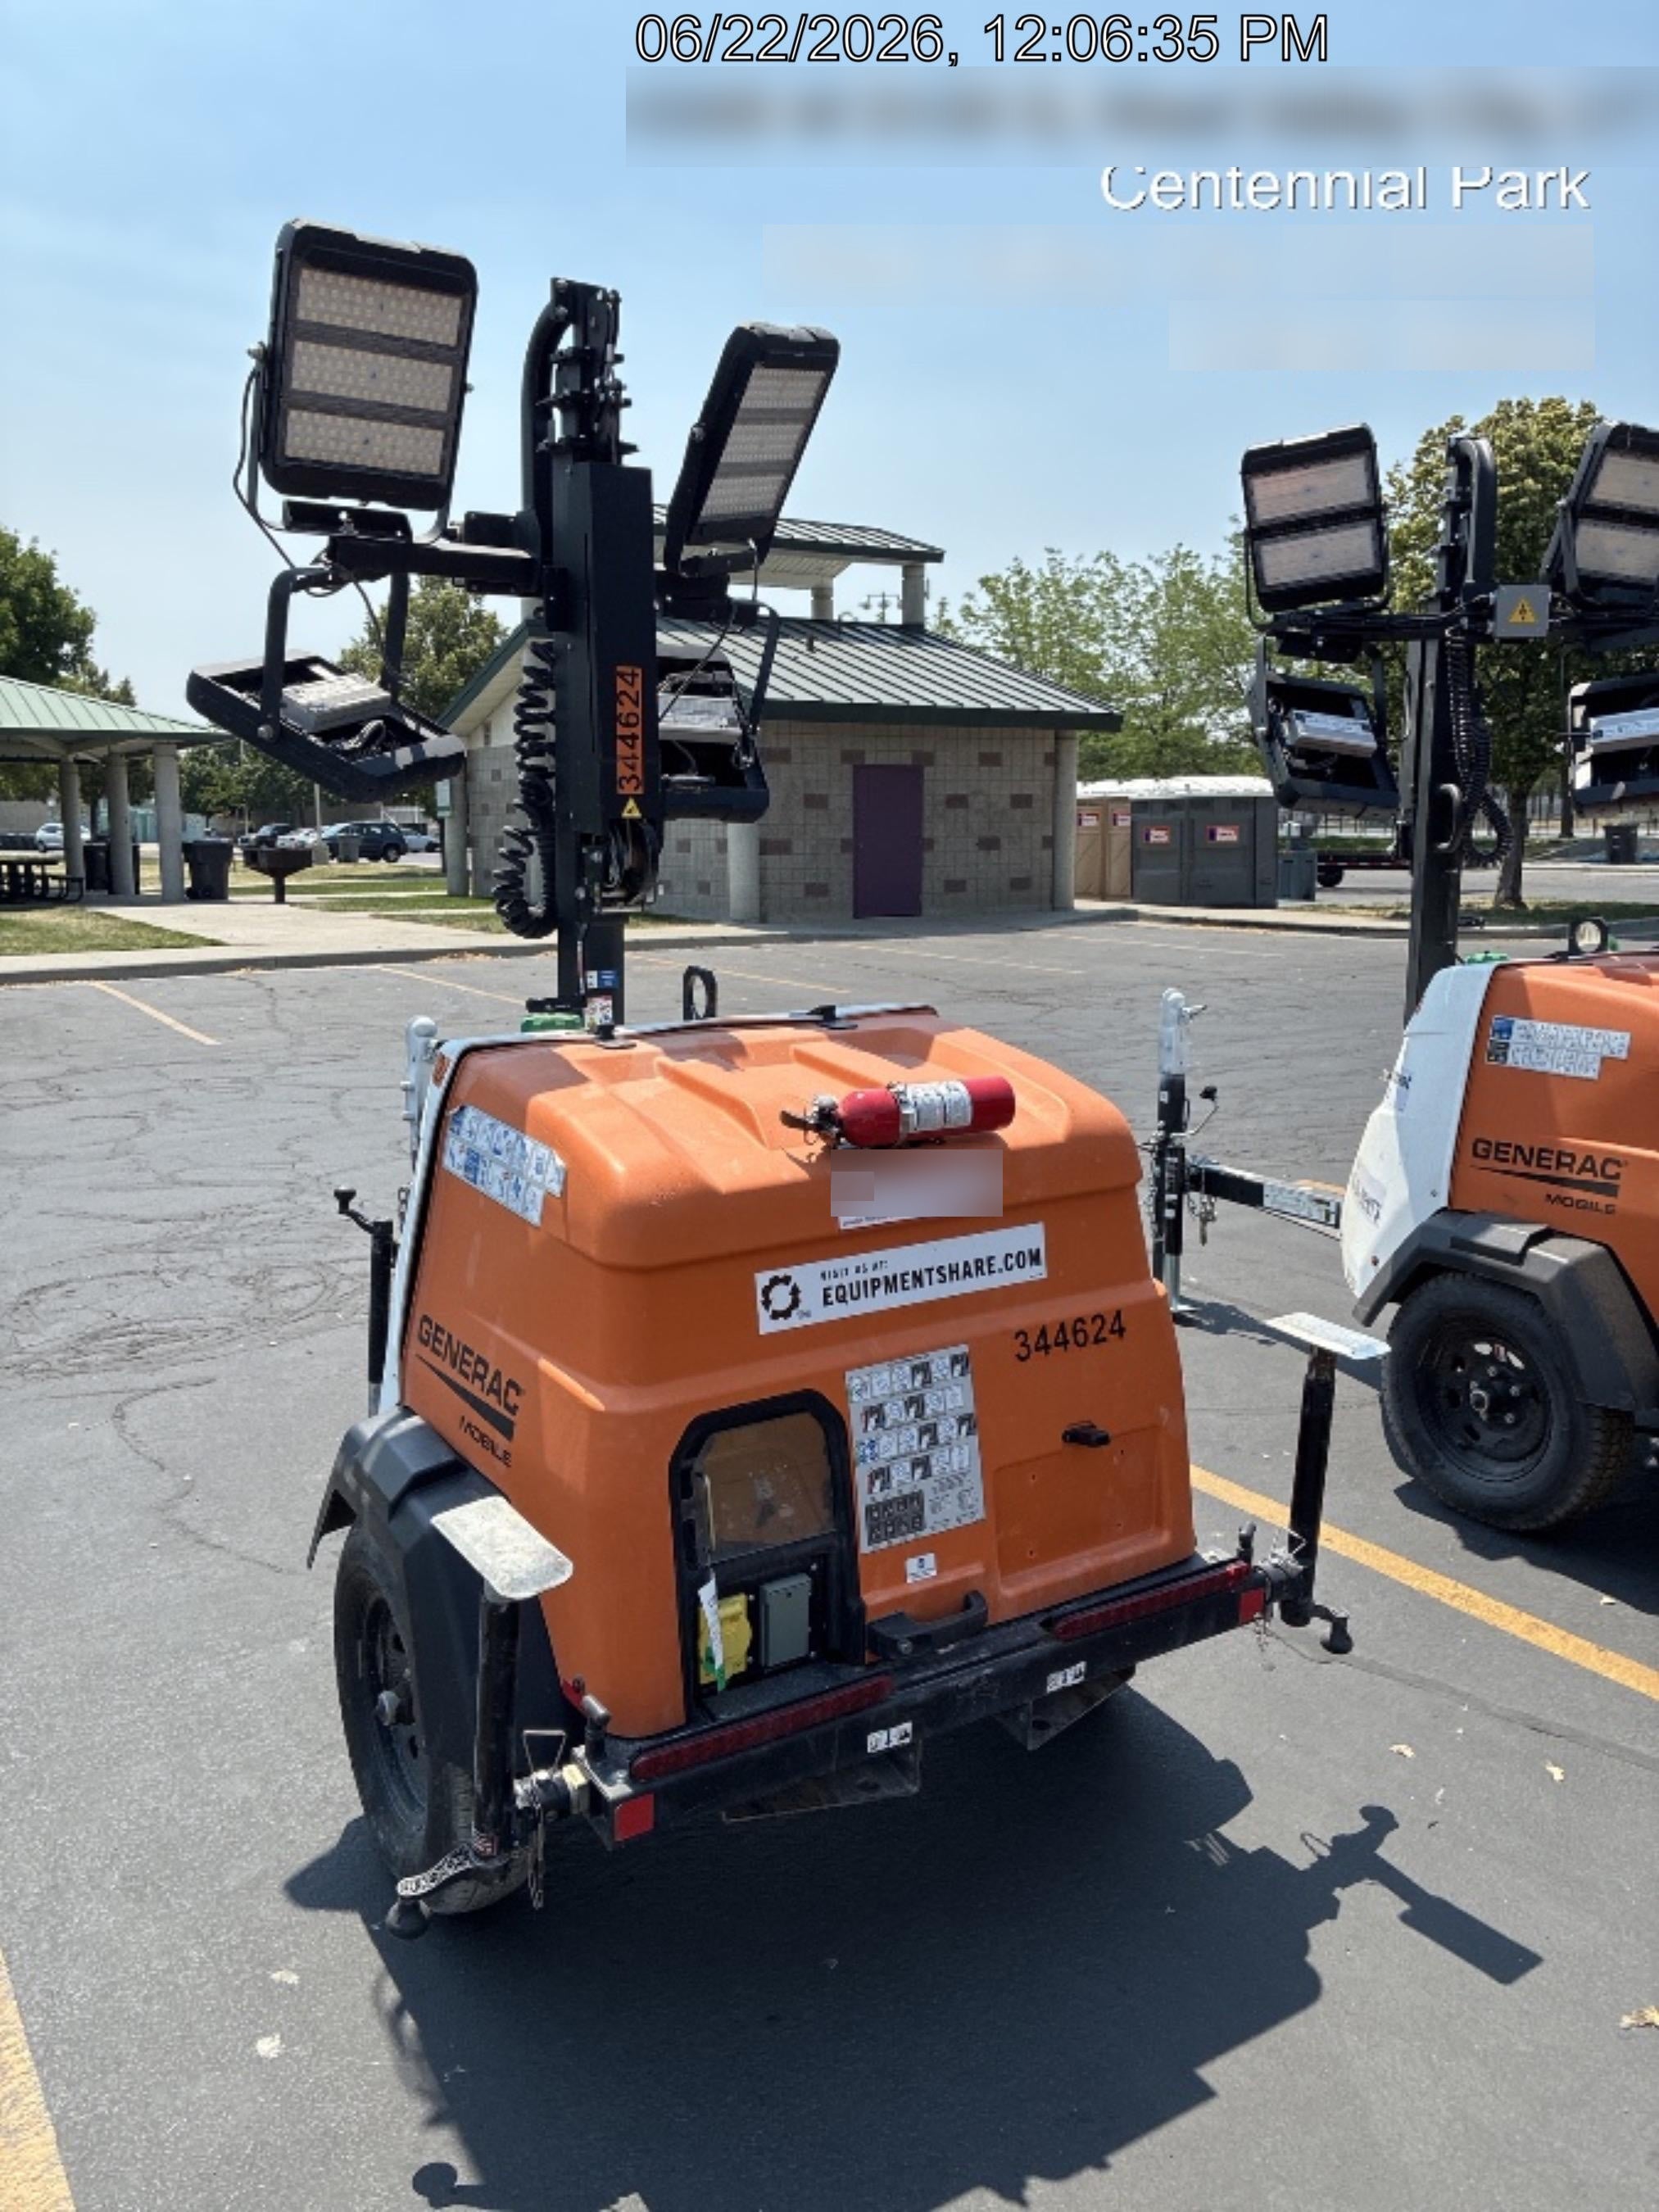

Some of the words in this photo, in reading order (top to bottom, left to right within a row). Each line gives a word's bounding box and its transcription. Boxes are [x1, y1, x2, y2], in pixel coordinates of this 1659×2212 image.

[618, 668, 641, 791] 344624
[1471, 1138, 1624, 1181] GENERAC
[823, 1247, 1041, 1308] EQUIPMENTSHARE.COM
[1014, 1309, 1126, 1362] 344624
[417, 1315, 522, 1416] GENERAC
[460, 1415, 513, 1468] MOBILE
